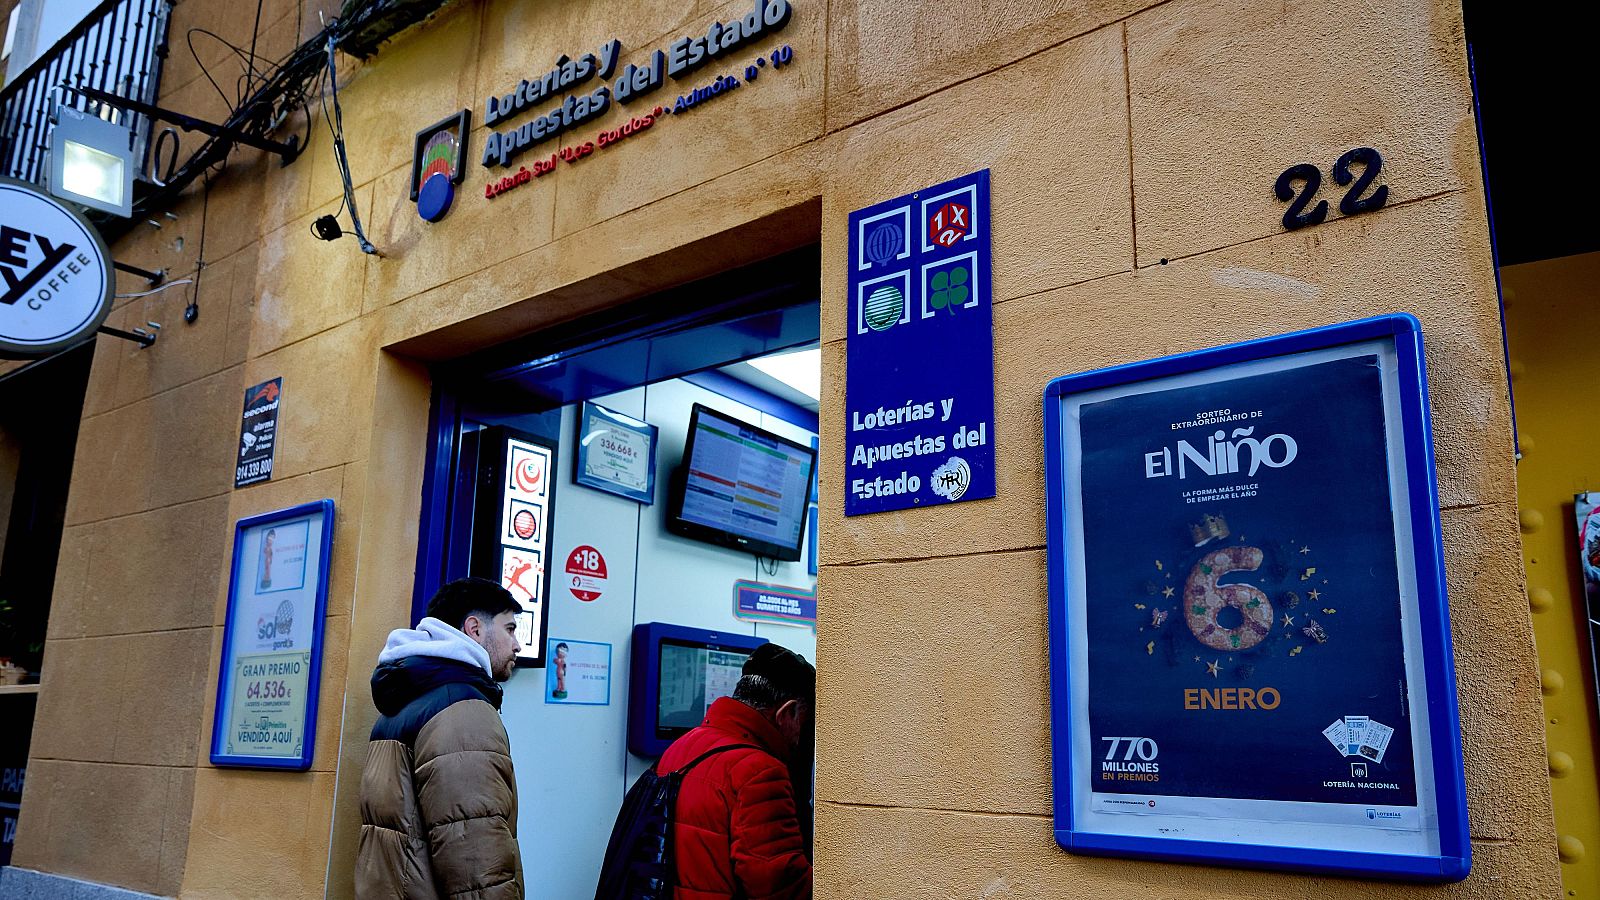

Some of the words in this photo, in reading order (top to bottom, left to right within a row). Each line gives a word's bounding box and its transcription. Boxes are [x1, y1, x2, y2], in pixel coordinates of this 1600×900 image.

[481, 86, 611, 168] Apuestas
[613, 49, 664, 105] del
[668, 0, 792, 81] Estado
[484, 53, 597, 127] Loterías
[597, 38, 621, 81] y
[532, 154, 557, 177] Sol
[770, 45, 793, 70] 10
[1275, 147, 1388, 229] 22
[27, 252, 92, 311] COFFEE
[852, 400, 935, 432] Loterías
[941, 398, 954, 422] y
[1171, 412, 1248, 430] EXTRAORDINARIO
[1250, 410, 1263, 418] DE
[1196, 408, 1231, 420] SORTEO
[600, 438, 632, 456] 336.668
[851, 434, 946, 469] Apuestas
[952, 422, 986, 450] del
[1144, 446, 1172, 479] El
[1177, 425, 1298, 480] Niño
[852, 471, 921, 500] Estado
[1192, 488, 1217, 497] FORMA
[1219, 485, 1234, 494] MÁS
[1235, 483, 1259, 491] DULCE
[1197, 493, 1230, 503] EMPEZAR
[1240, 490, 1257, 498] AÑO
[574, 550, 599, 570] +18
[242, 664, 266, 677] GRAN
[268, 662, 300, 676] PREMIO
[247, 680, 286, 699] 64.536
[1184, 687, 1281, 710] ENERO
[238, 731, 270, 743] VENDIDO
[272, 728, 293, 744] AQUÍ
[1101, 736, 1159, 762] 770
[1102, 761, 1159, 773] MILLONES
[1102, 772, 1114, 780] EN
[1117, 773, 1160, 782] PREMIOS
[1323, 780, 1356, 788] LOTERÍA
[1357, 782, 1400, 790] NACIONAL
